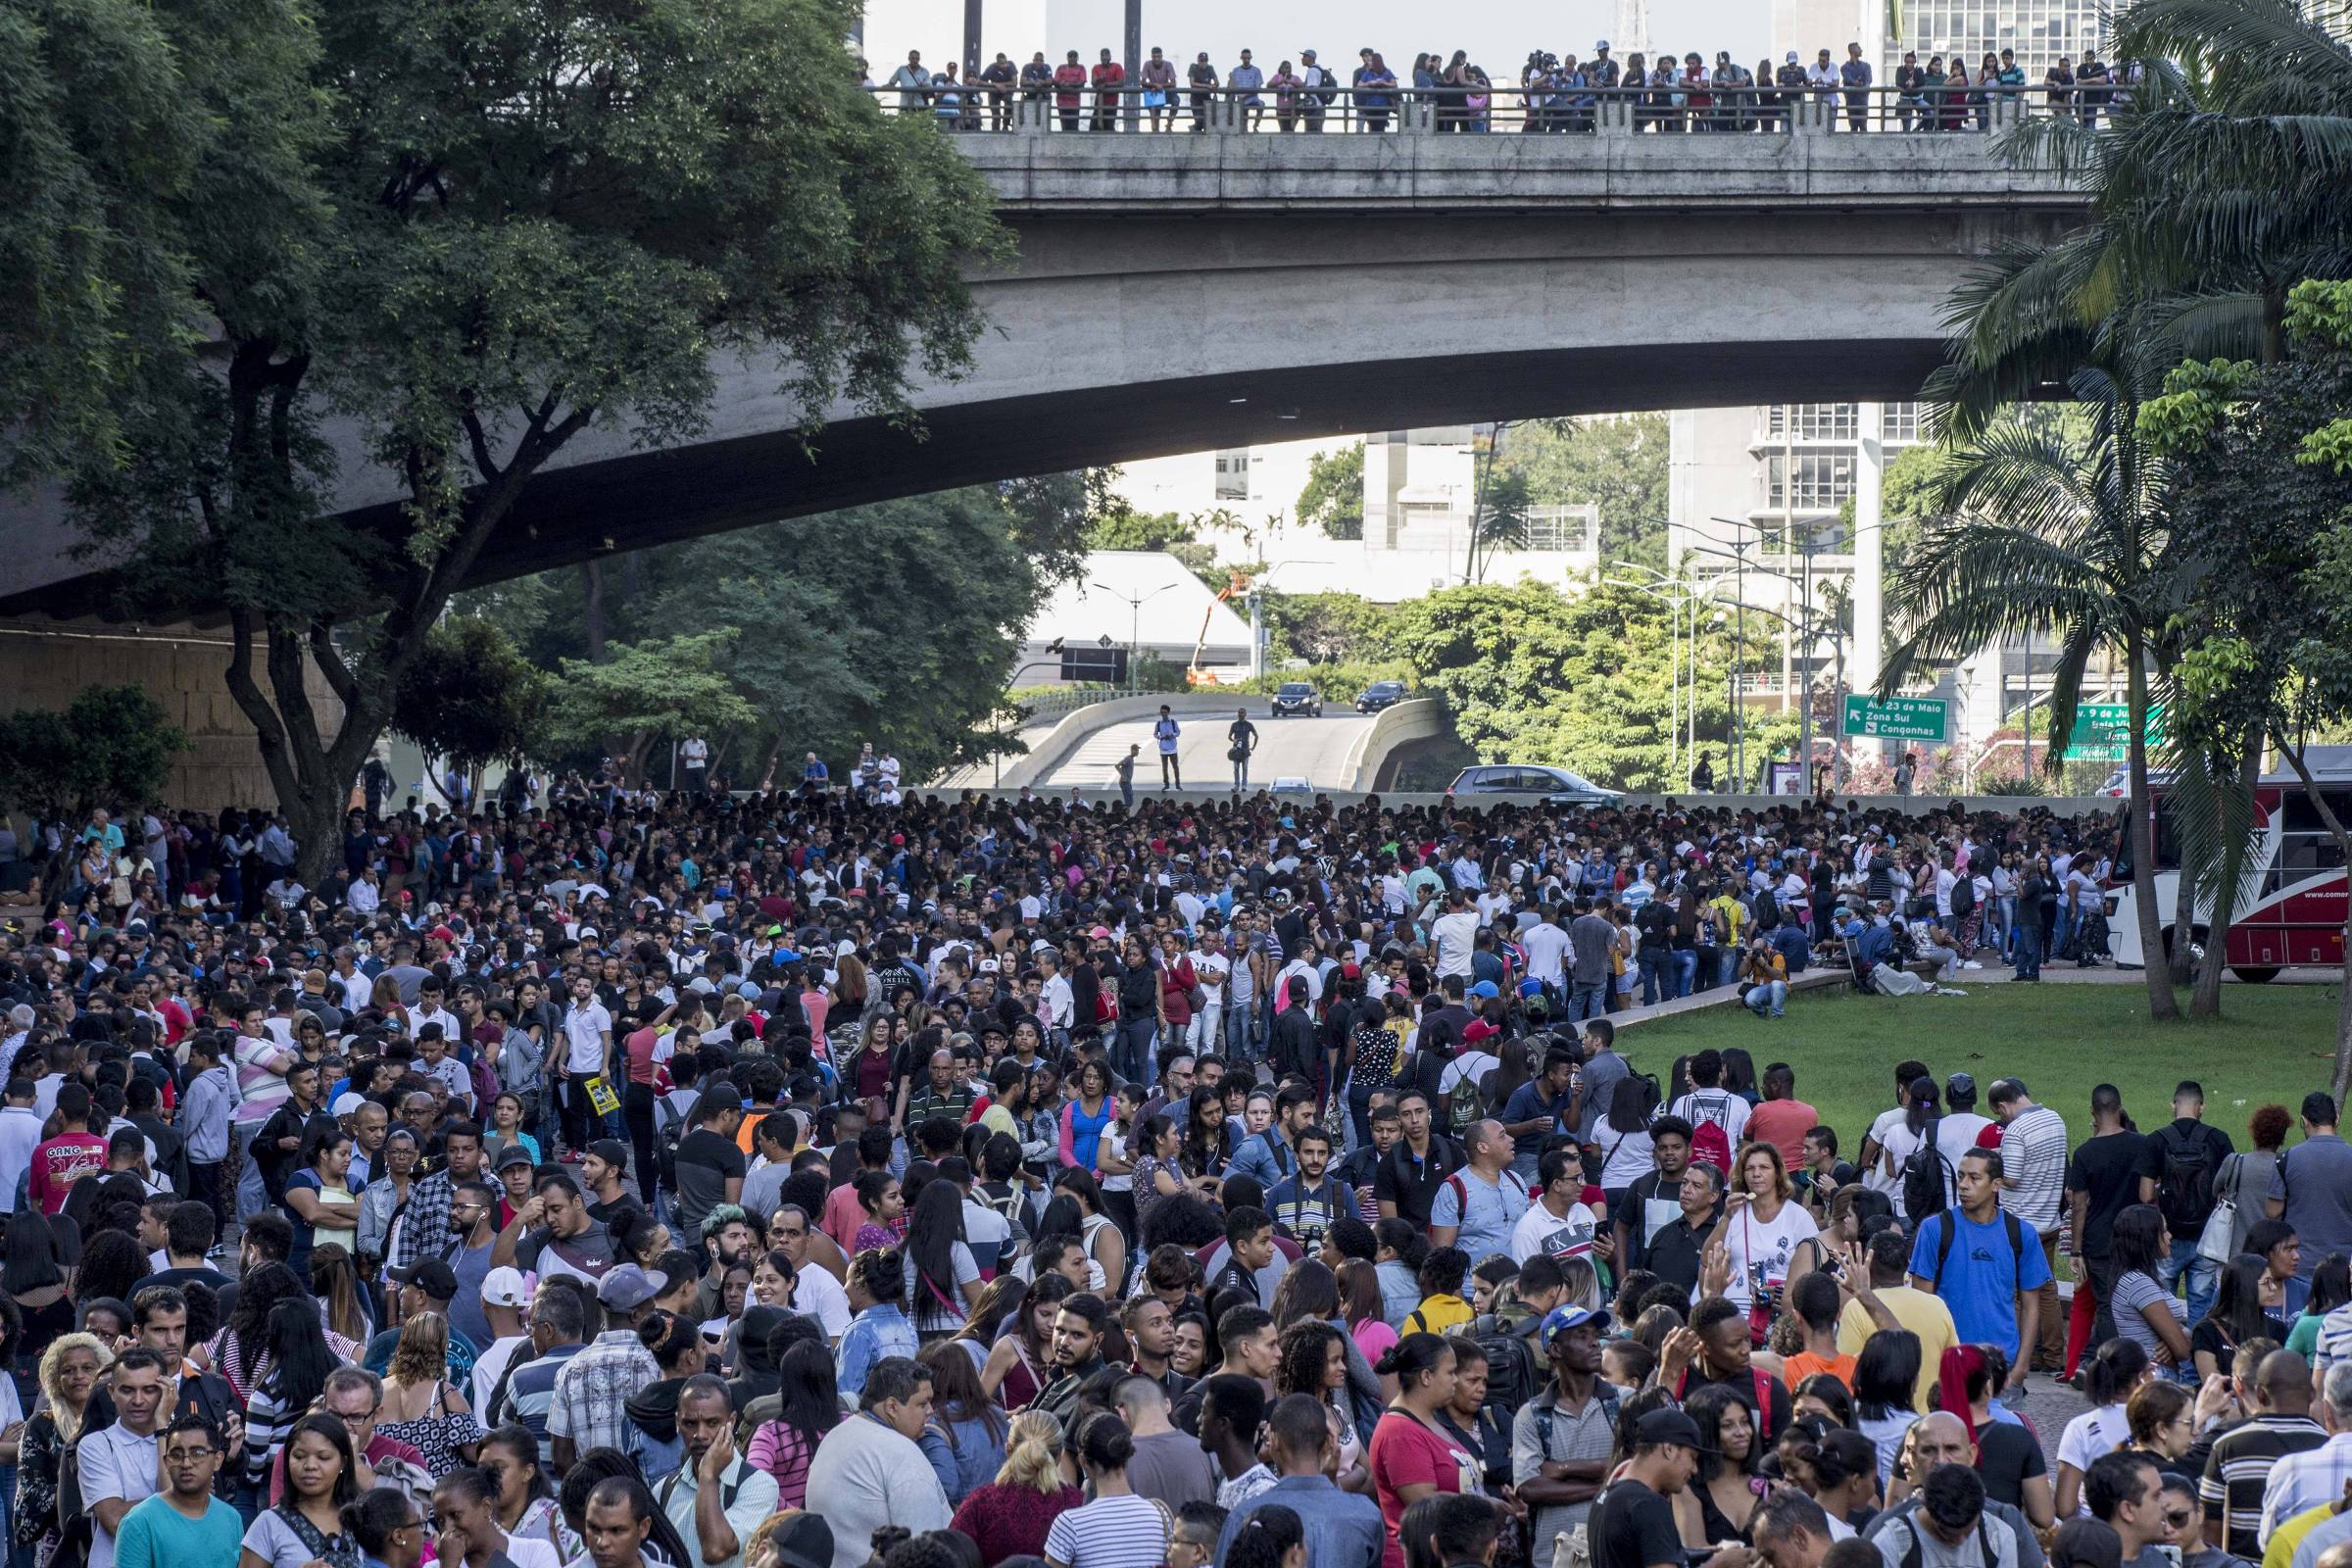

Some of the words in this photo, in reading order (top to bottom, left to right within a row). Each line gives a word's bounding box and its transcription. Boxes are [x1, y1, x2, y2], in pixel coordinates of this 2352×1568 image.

[1886, 702, 1899, 710] 23
[1918, 703, 1941, 712] Maio
[1866, 712, 1890, 721] Zona
[1893, 713, 1910, 722] Sul
[2089, 709, 2096, 717] 9
[1880, 724, 1935, 736] Congonhas
[47, 1146, 80, 1157] GANG
